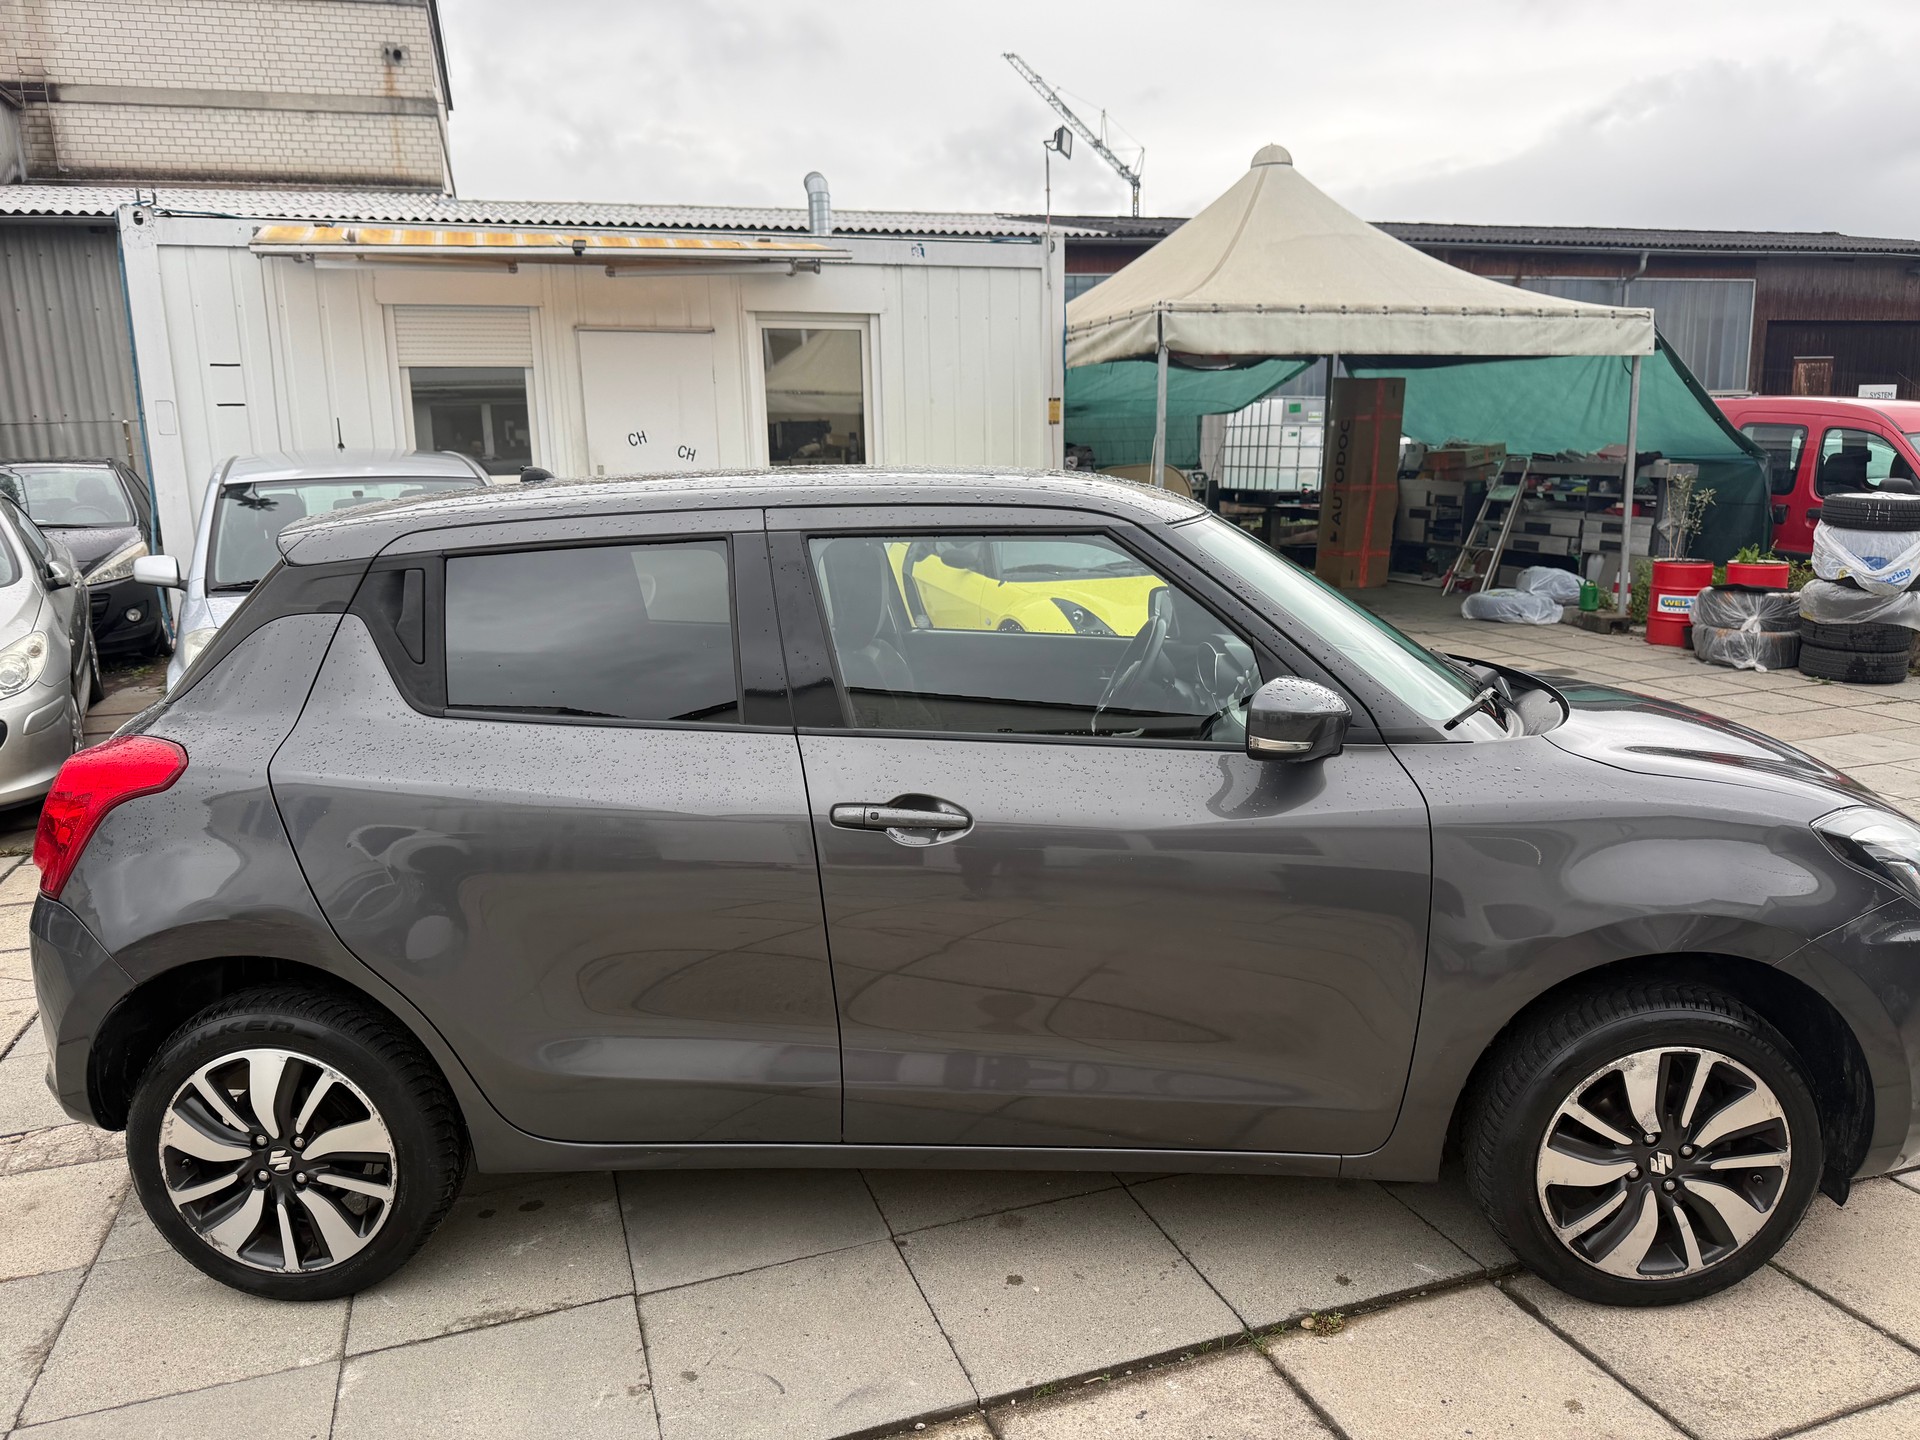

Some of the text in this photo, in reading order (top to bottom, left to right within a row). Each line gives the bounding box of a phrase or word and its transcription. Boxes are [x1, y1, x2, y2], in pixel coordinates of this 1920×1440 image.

[628, 430, 648, 447] CH
[677, 445, 697, 462] CH
[1331, 419, 1350, 526] AUTODOC
[1882, 568, 1911, 584] uring
